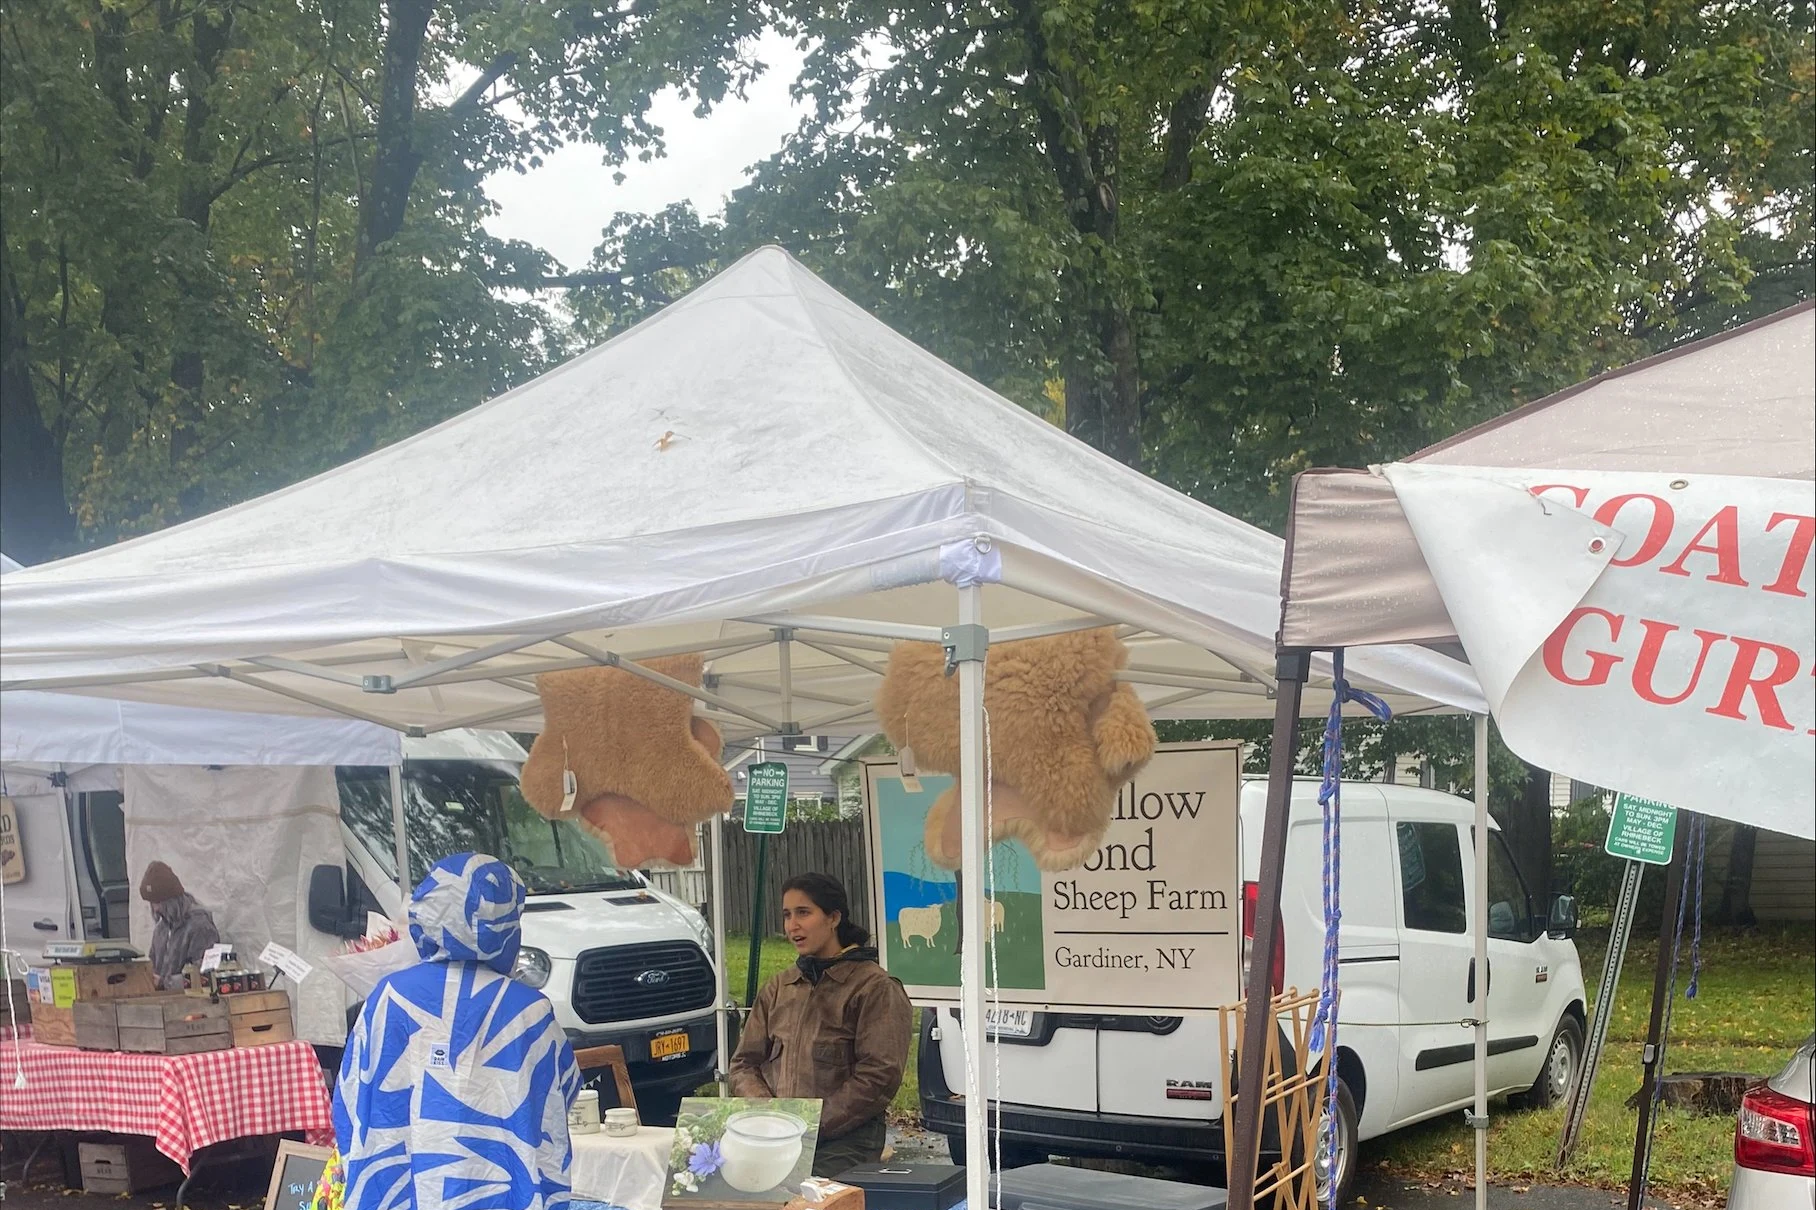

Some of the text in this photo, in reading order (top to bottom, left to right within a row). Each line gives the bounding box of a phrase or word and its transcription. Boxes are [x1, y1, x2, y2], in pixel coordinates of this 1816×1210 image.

[1542, 606, 1815, 735] GUR
[763, 768, 775, 777] NO
[751, 777, 785, 787] PARKING
[1111, 779, 1206, 821] llow
[1639, 807, 1673, 818] MIDNIGHT
[1626, 817, 1641, 826] MAY
[1653, 816, 1669, 824] 3PM
[1623, 824, 1652, 836] VILLAGE
[1621, 830, 1662, 844] RHINEBECK
[1065, 828, 1157, 872] ond
[1054, 880, 1228, 919] Sheep Farm
[1055, 946, 1196, 972] Gardiner, NY
[646, 973, 664, 984] Ford
[1166, 1079, 1213, 1089] RAM
[307, 1181, 313, 1193] A
